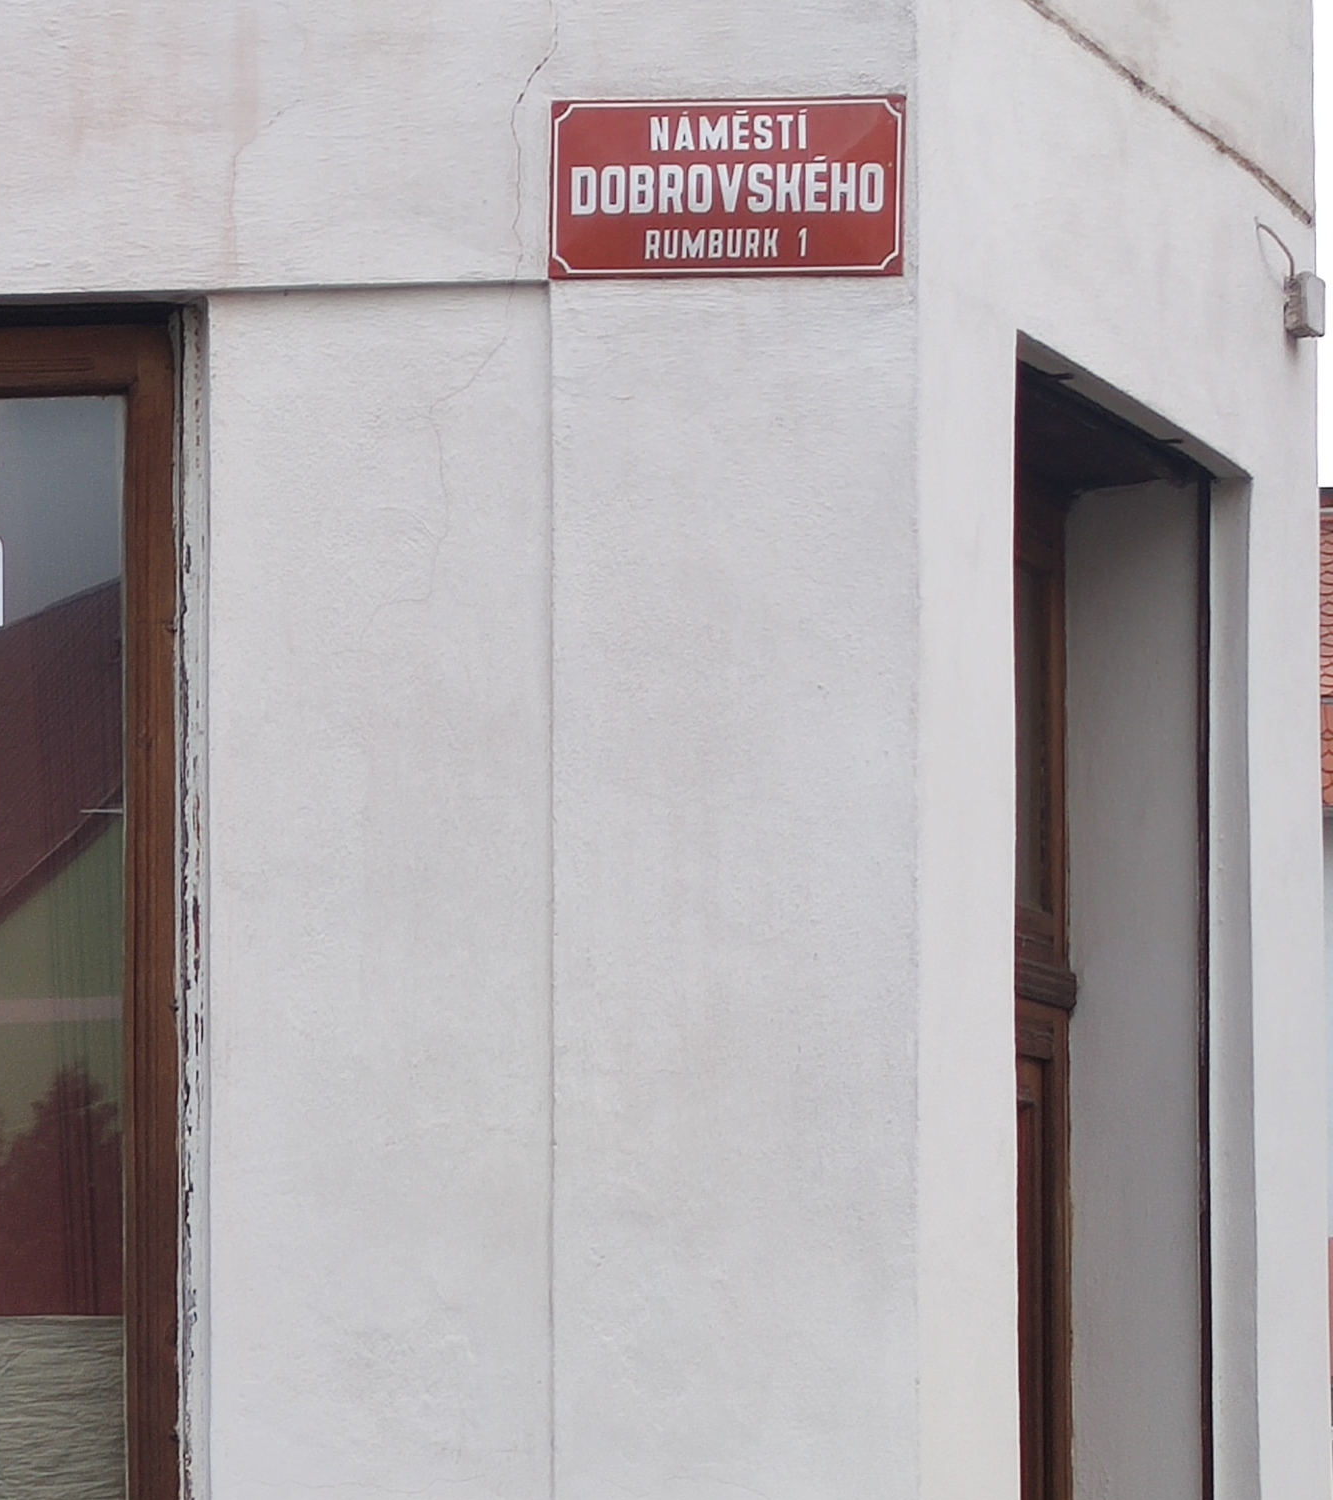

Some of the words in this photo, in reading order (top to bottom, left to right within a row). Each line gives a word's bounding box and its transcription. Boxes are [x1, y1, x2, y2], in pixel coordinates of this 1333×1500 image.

[649, 109, 808, 151] NÁMĚSTÍ
[570, 155, 885, 216] DOBROVSKÉHO
[644, 228, 780, 260] RUMBURK
[797, 227, 808, 257] 1
